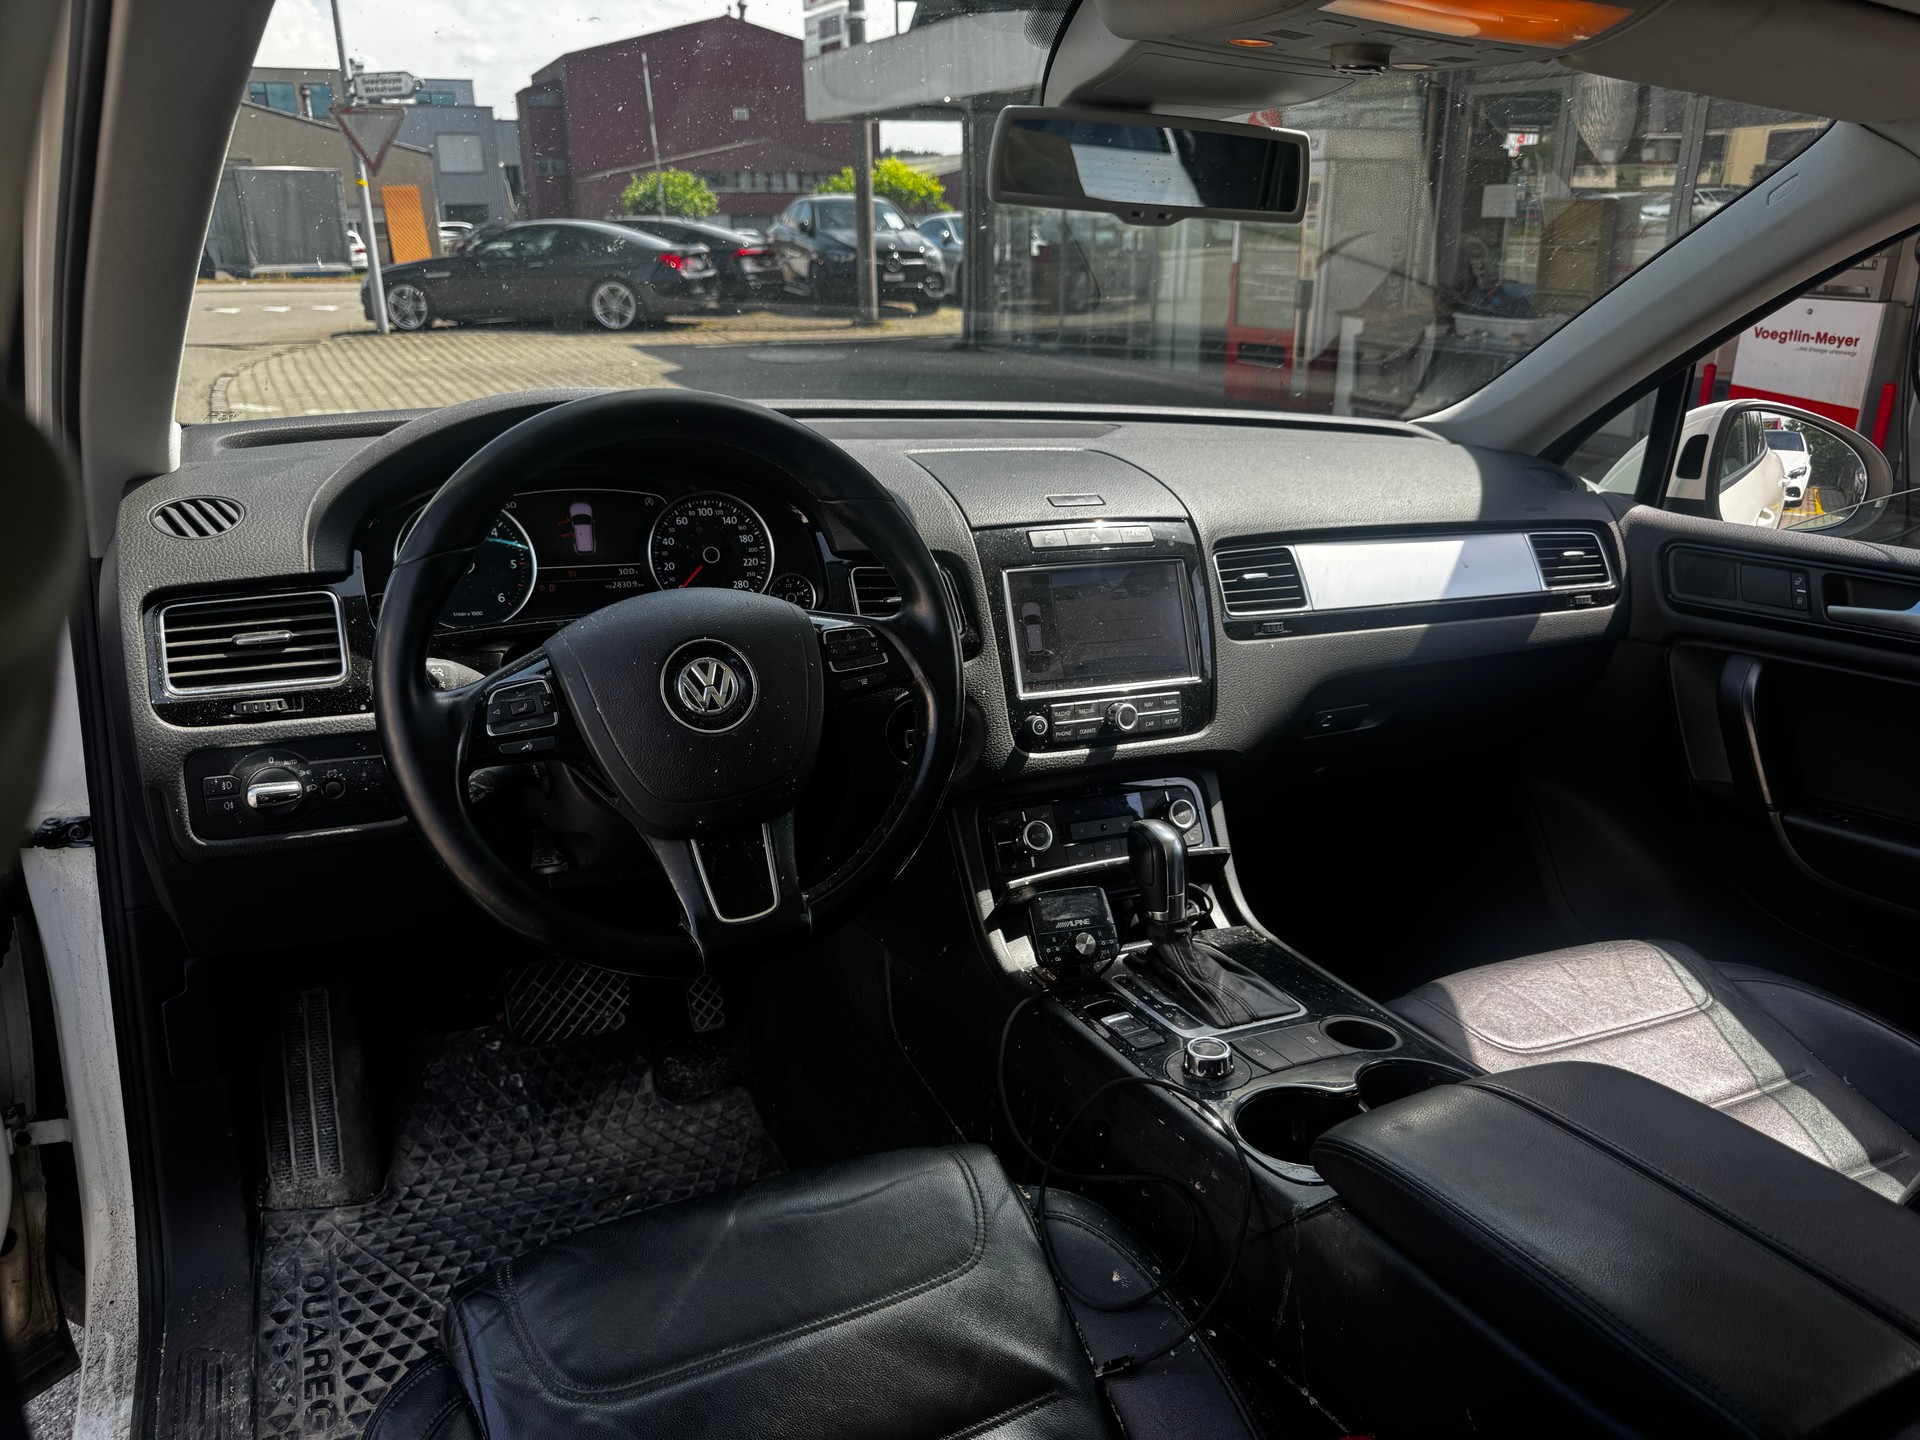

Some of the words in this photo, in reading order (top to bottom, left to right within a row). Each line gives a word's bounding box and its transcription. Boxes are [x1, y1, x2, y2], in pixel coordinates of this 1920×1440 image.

[1754, 325, 1860, 349] Voegtlin-Meyer
[697, 507, 714, 517] 100
[675, 516, 689, 526] 60
[722, 516, 738, 526] 140
[490, 527, 499, 537] 4
[662, 537, 675, 546] 40
[738, 534, 754, 543] 180
[509, 559, 518, 570] 5
[663, 562, 675, 571] 20
[742, 558, 759, 567] 220
[612, 580, 638, 589] 2830.9
[732, 580, 749, 589] 280
[497, 592, 506, 603] 6
[1055, 710, 1071, 718] RADIO
[1078, 707, 1095, 715] MEDIA
[1165, 717, 1179, 725] SETUP
[1055, 729, 1072, 737] PHONE
[1066, 918, 1092, 928] ALPINE
